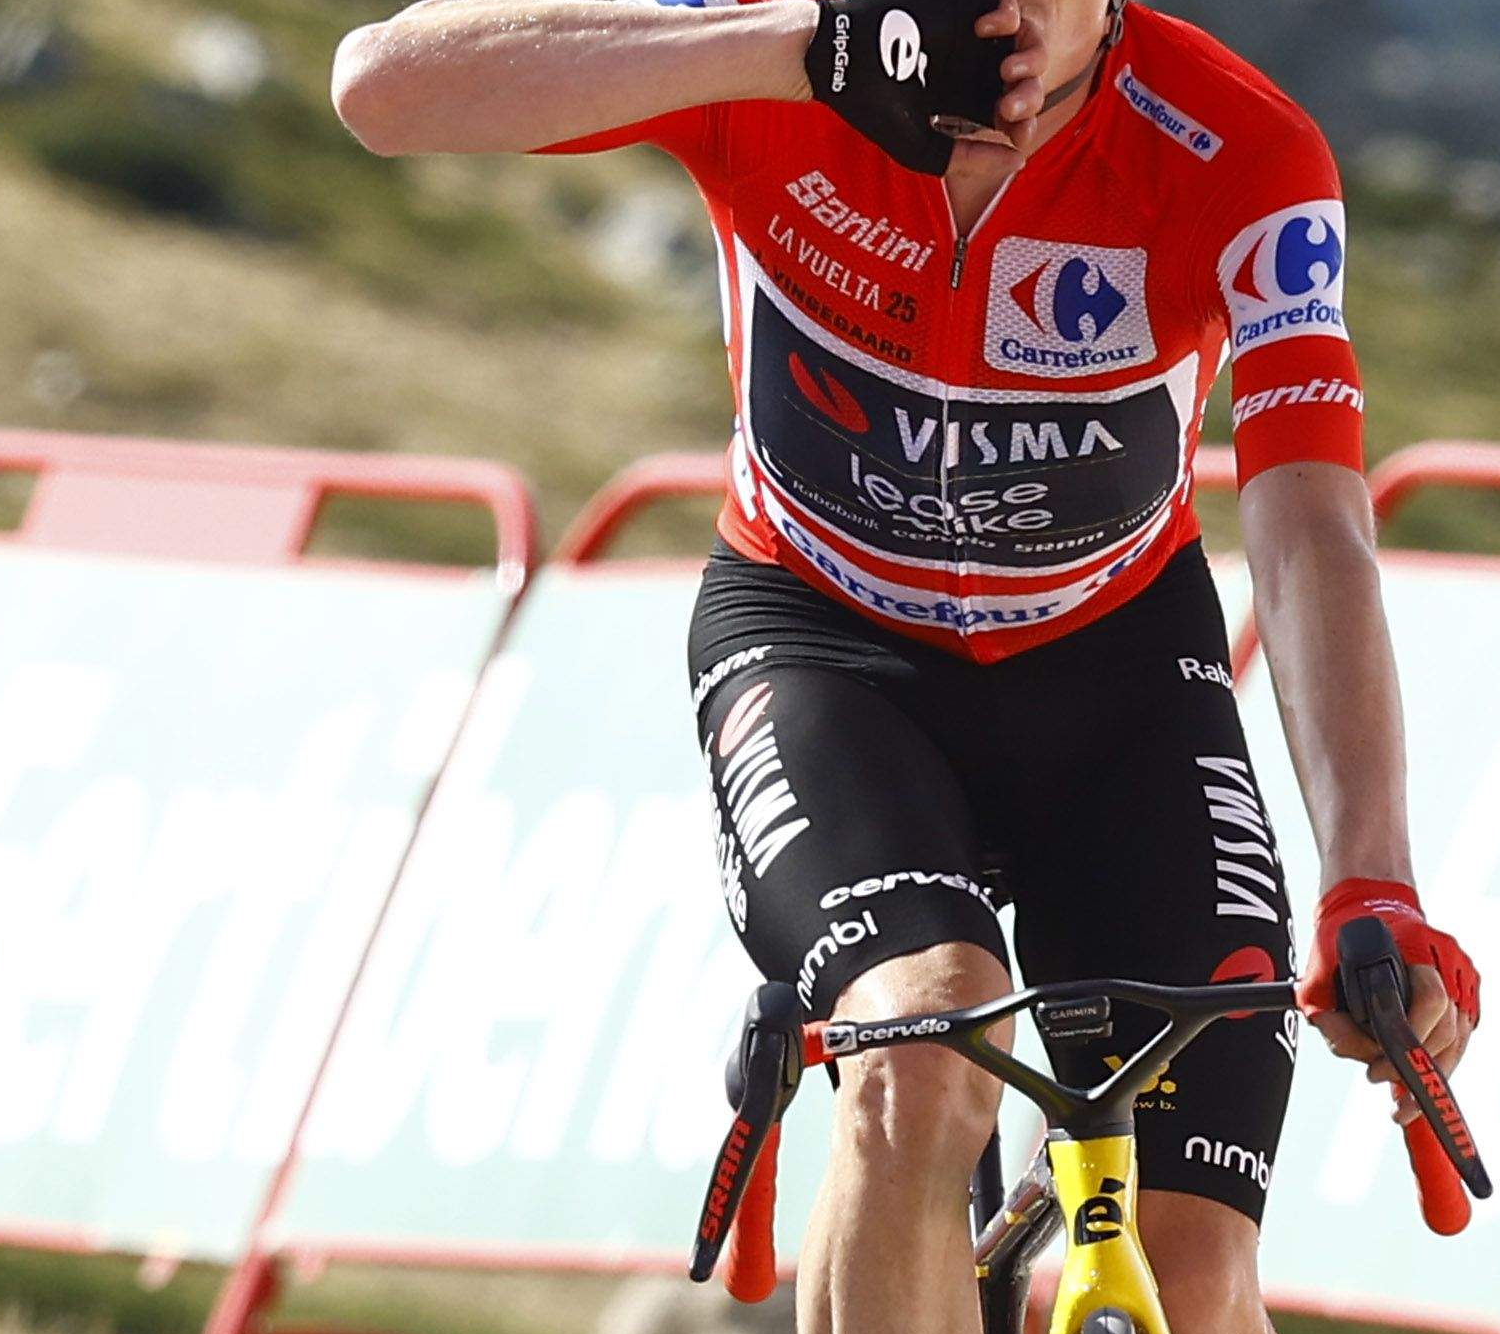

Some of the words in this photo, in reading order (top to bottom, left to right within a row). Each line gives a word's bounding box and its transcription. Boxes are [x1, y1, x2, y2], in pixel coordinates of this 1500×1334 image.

[831, 14, 850, 93] GripGrab
[1124, 75, 1187, 136] Carrefour
[785, 169, 936, 273] Santini
[767, 214, 793, 254] LA
[798, 238, 880, 311] VUELTA
[885, 291, 917, 323] 25
[1001, 338, 1140, 368] Carrefour
[1236, 299, 1342, 348] Carrefou
[894, 407, 1124, 468] VISMA
[851, 452, 1049, 520] lease
[782, 517, 1061, 628] Carrefour
[1196, 755, 1278, 924] VISMA
[796, 910, 878, 1012] nimbl
[1051, 1008, 1097, 1019] GARMIN
[1407, 1047, 1477, 1159] SRAM
[701, 1116, 753, 1244] SRAM
[1185, 1137, 1274, 1191] nimb
